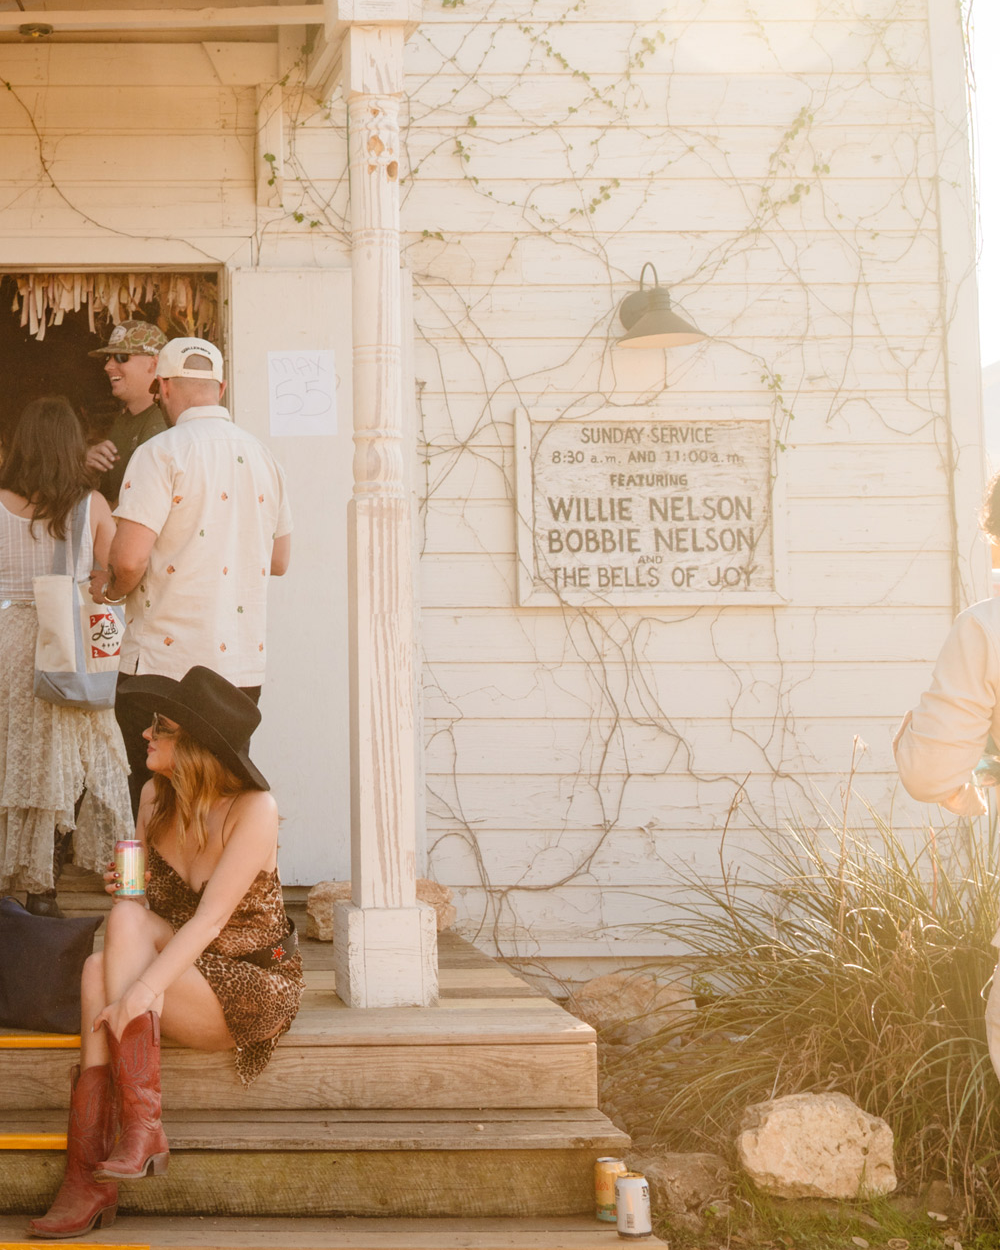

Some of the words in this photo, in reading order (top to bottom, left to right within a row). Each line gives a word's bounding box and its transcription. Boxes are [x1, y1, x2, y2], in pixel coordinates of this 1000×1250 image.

[275, 378, 333, 417] 55
[580, 427, 644, 444] SUNDAY
[650, 426, 714, 443] SERVICE
[551, 451, 585, 464] 8:30
[628, 451, 656, 463] AND
[609, 474, 688, 487] FEATURING
[547, 497, 633, 522] WILLIE
[649, 496, 752, 521] NELSON
[548, 528, 641, 553] BOBBIE
[653, 527, 755, 552] NELSON
[637, 555, 663, 564] AND
[550, 567, 590, 587] THE
[598, 567, 660, 587] BELLS
[671, 566, 699, 587] OF
[707, 565, 758, 588] JOY
